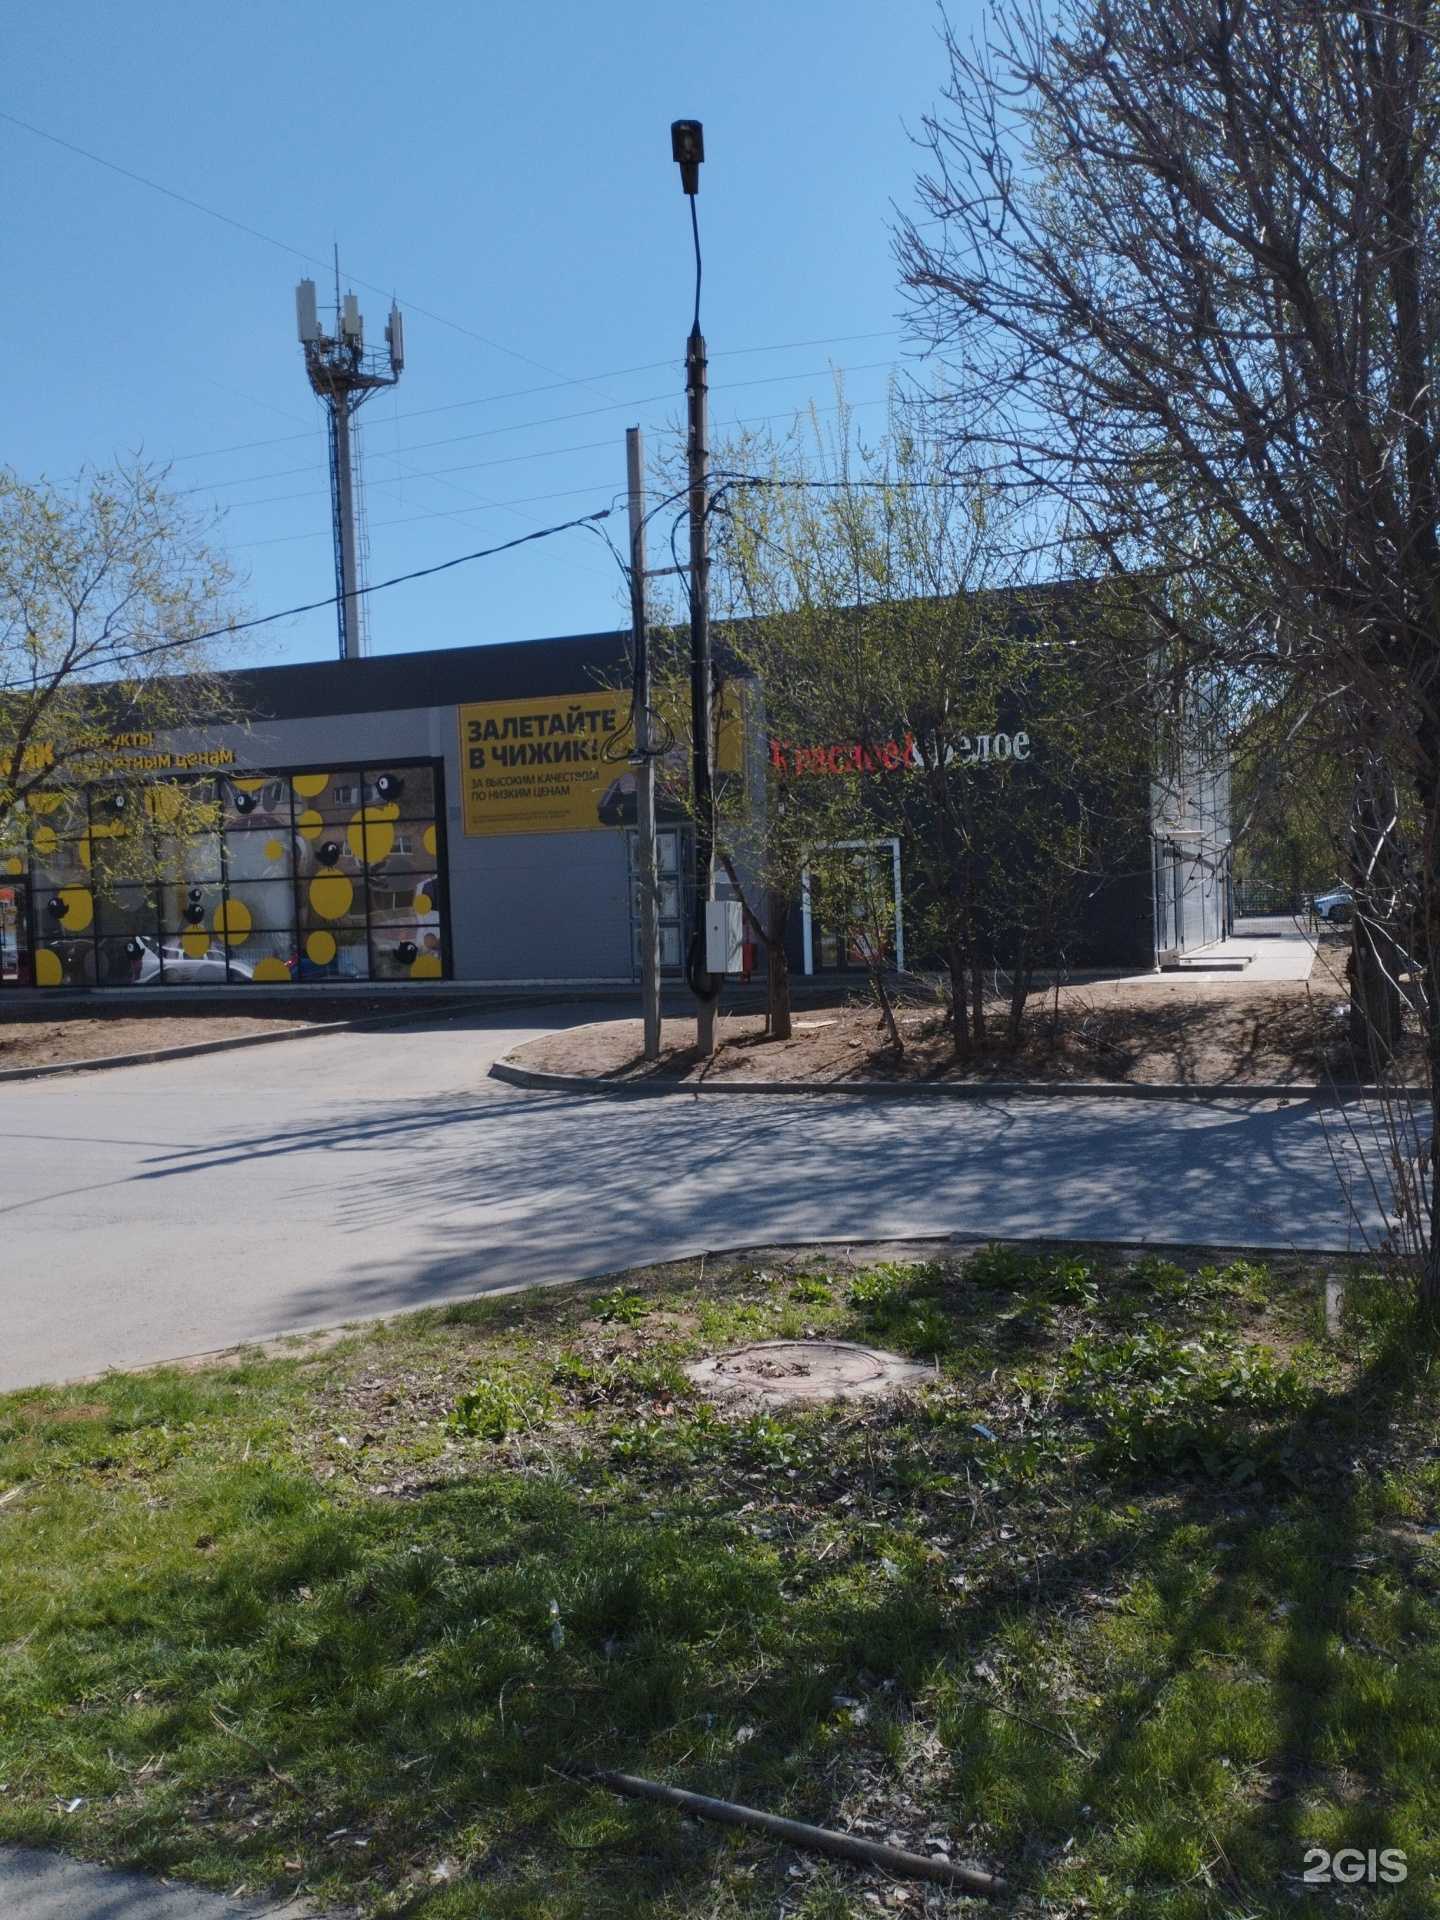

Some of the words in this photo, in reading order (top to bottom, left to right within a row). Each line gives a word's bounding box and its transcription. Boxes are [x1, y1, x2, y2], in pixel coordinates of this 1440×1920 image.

[468, 705, 616, 742] ЗАЛЕТАЙТЕ
[470, 747, 485, 769] В
[492, 740, 598, 767] ЧИЖИК!
[471, 778, 484, 790] ЗА
[485, 774, 535, 787] ВЫСОКИМ
[472, 789, 486, 801] ПО
[488, 787, 531, 800] НИЗКИМ
[533, 785, 571, 799] ЦЕНАМ
